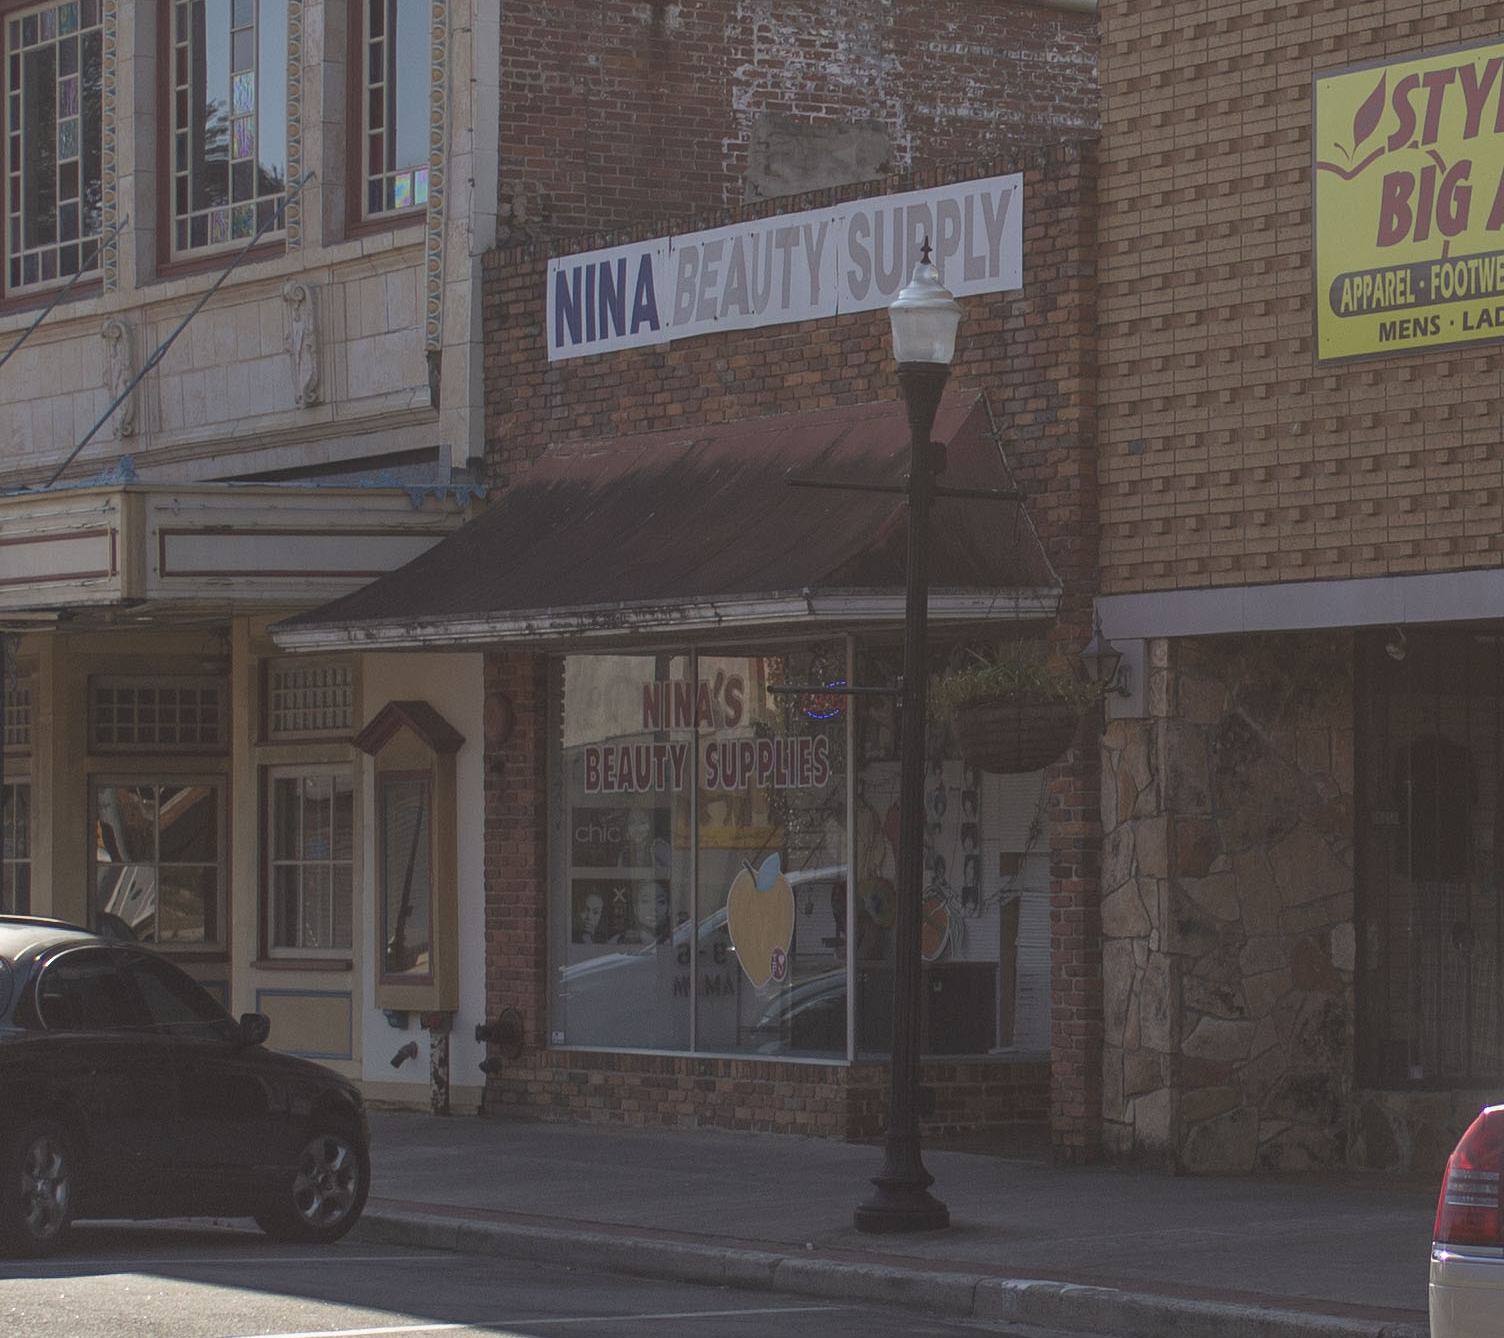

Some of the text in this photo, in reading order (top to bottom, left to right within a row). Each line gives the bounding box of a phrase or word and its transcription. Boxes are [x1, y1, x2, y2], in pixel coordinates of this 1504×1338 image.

[1376, 159, 1472, 248] BIG
[555, 188, 1012, 349] NINA BEAUTY SUPPLY
[1340, 272, 1416, 314] APPAREL
[1378, 315, 1441, 343] MENS
[642, 668, 746, 730] NINA'S
[584, 735, 830, 793] BEAUTY SUPPLIES
[575, 823, 622, 843] chic
